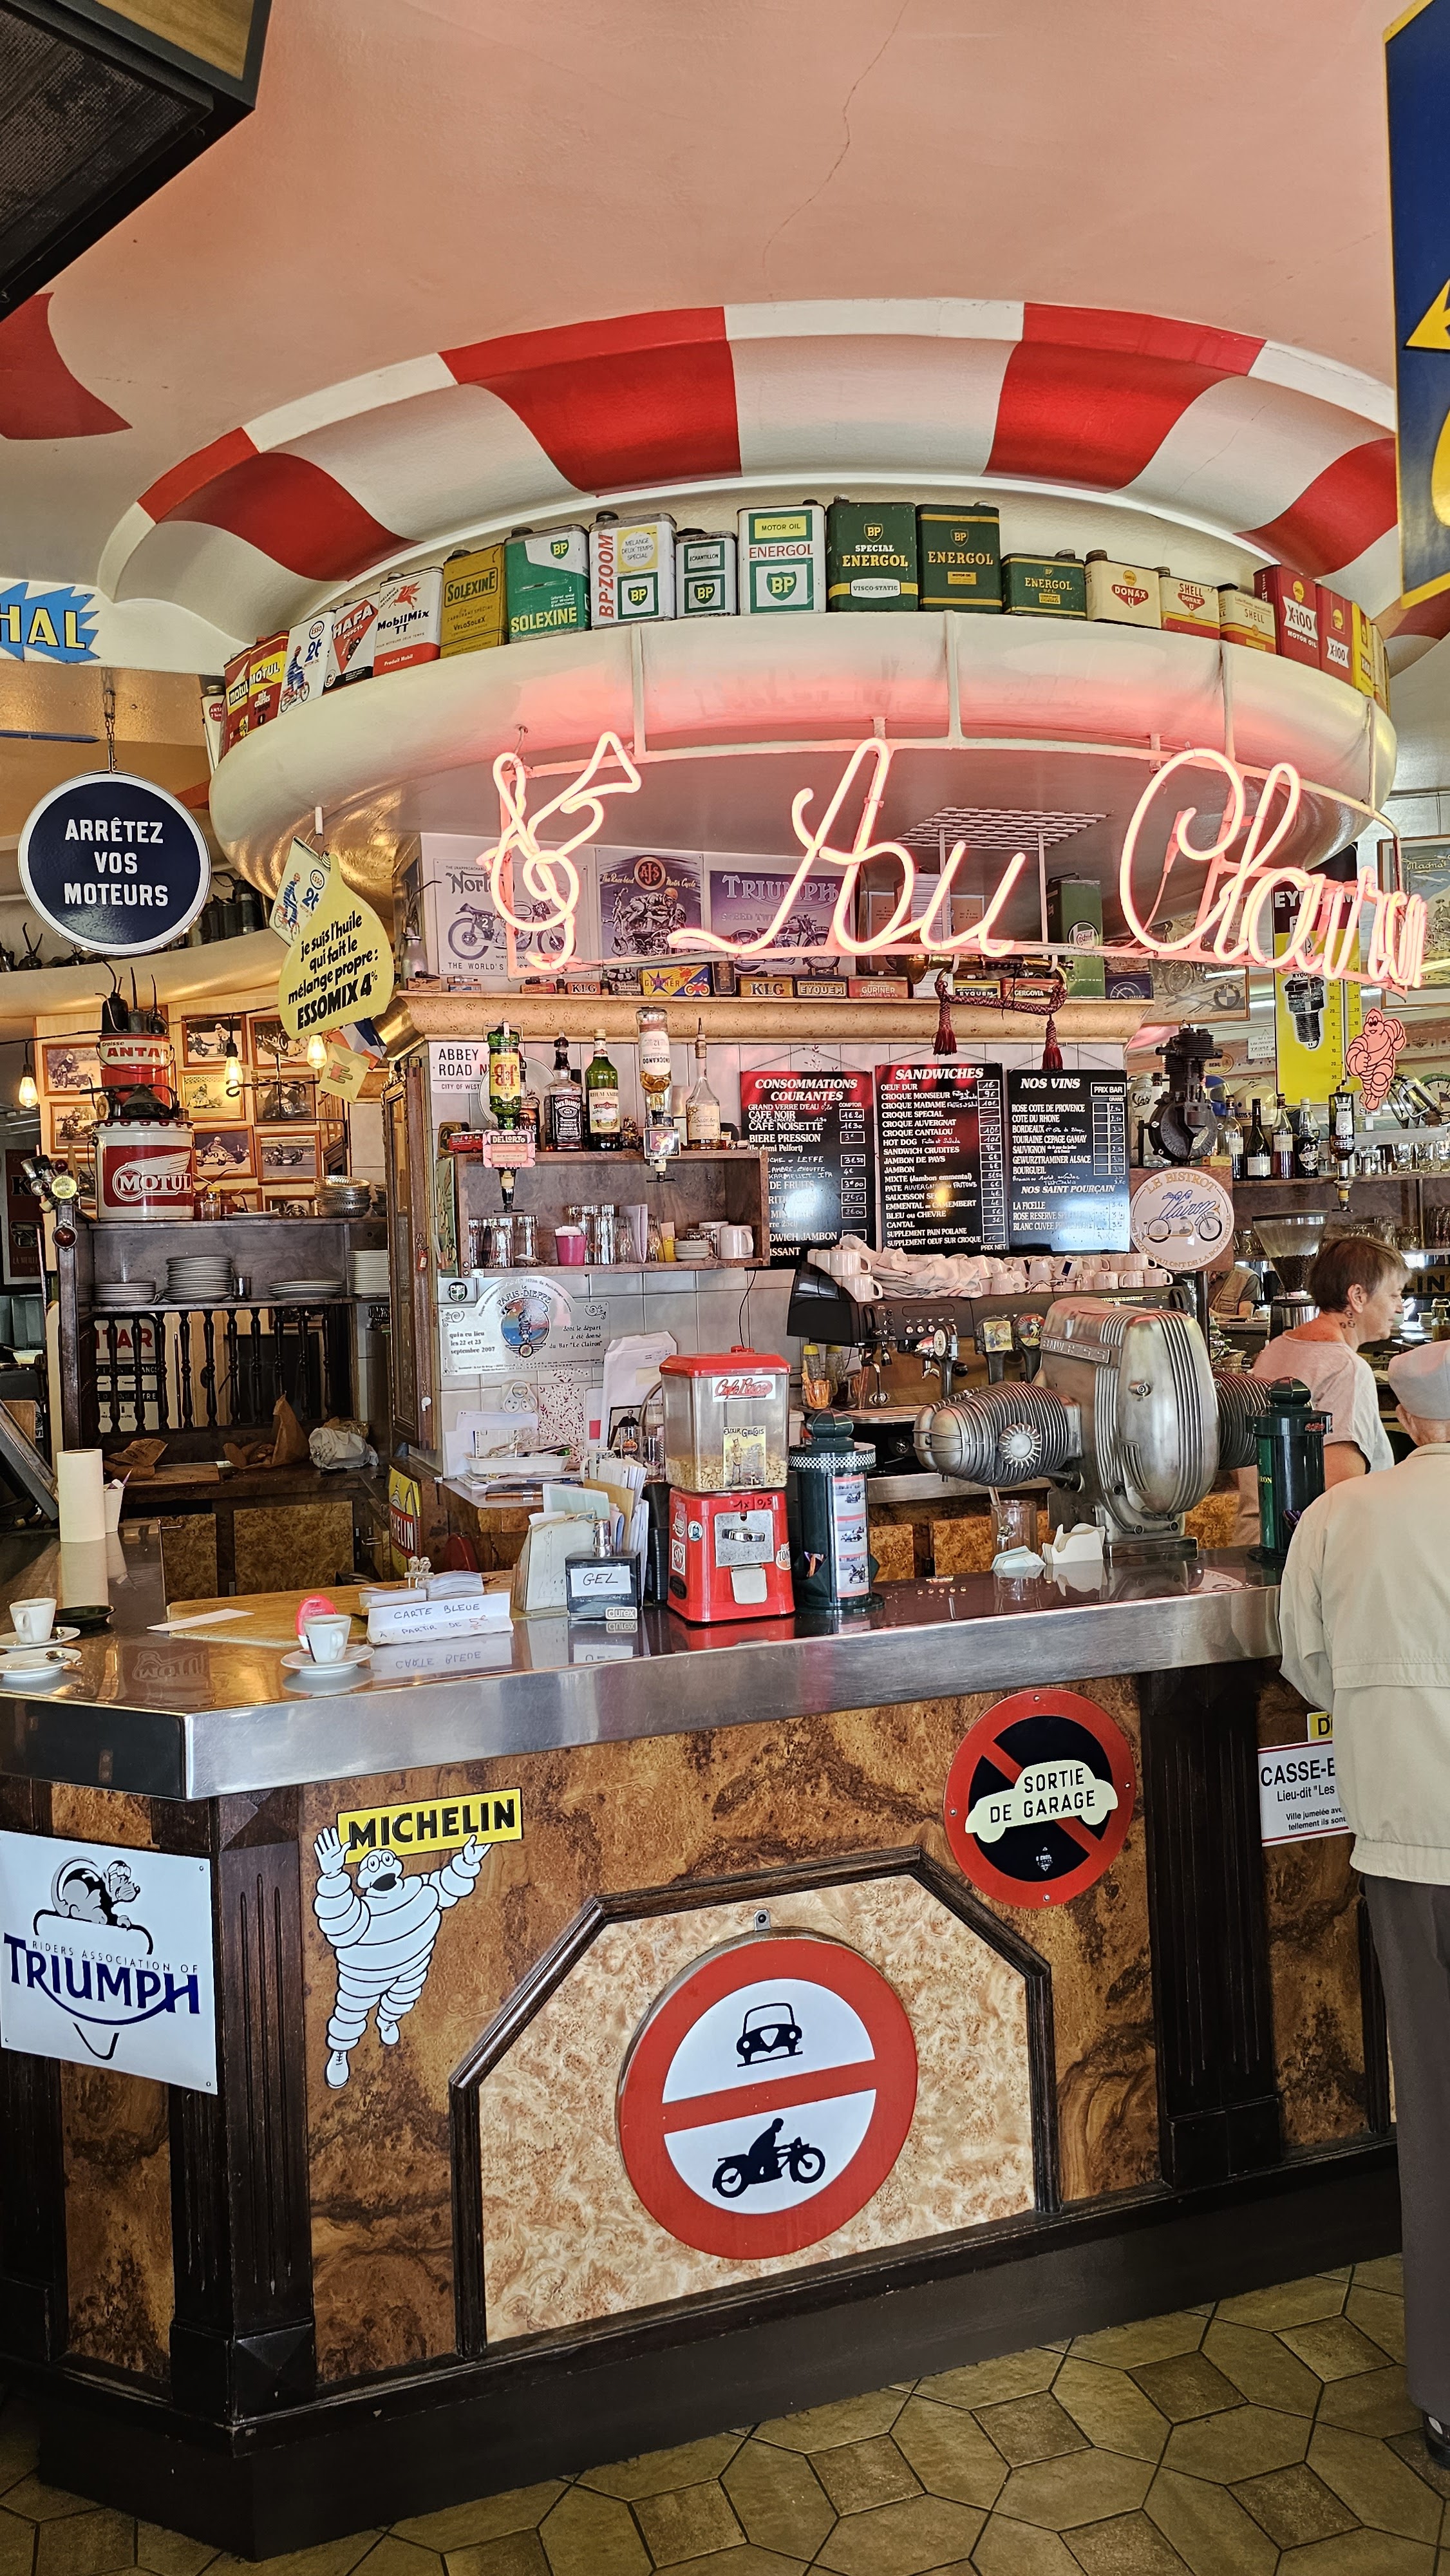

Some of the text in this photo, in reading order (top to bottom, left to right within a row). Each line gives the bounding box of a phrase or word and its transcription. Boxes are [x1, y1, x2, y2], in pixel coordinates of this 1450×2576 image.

[867, 527, 881, 536] BP
[954, 532, 966, 542] BP
[553, 543, 568, 555] BP
[749, 544, 813, 558] ENERGOL
[842, 555, 909, 567] ENERGOL
[928, 551, 993, 565] ENERGOL
[447, 571, 495, 602] SOLEXINE
[771, 576, 795, 593] BP
[1025, 577, 1073, 591] ENERGOL
[1179, 583, 1203, 598] SHELL
[630, 589, 646, 601] BP
[697, 587, 713, 600] BP
[1115, 585, 1146, 600] DONAX
[1127, 597, 1134, 607] U
[1182, 595, 1201, 605] DONAX
[332, 605, 375, 639] HAFA
[377, 611, 429, 631] MobilMix
[511, 607, 576, 633] SOLEXINE
[1245, 609, 1265, 623] SHELL
[394, 623, 408, 634] TT
[1288, 630, 1317, 648] MOTOR OIL
[1330, 643, 1345, 661] X-100
[384, 654, 413, 666] Produit Mobil
[249, 661, 280, 686] MOTUL
[229, 679, 249, 703] motul
[65, 817, 163, 845] ARRÊTEZ
[668, 737, 1027, 957] Au
[94, 852, 138, 874] VOS
[639, 862, 660, 884] AJS
[64, 883, 169, 907] MOTEURS
[482, 918, 489, 928] 2
[301, 940, 310, 963] je
[311, 929, 330, 951] suis
[310, 935, 358, 974] qui fait le
[288, 971, 334, 1005] mélange
[572, 984, 596, 994] KLG
[751, 983, 784, 996] KLG
[800, 985, 844, 996] EYQUEM
[297, 978, 359, 1031] ESSOMIX
[107, 1047, 169, 1059] ANTAR
[438, 1048, 479, 1061] ABBEY
[439, 1065, 472, 1076] ROAD
[896, 1068, 984, 1080] SANDWICHES
[755, 1079, 858, 1089] CONSOMMATIONS
[1020, 1078, 1080, 1088] NOS VINS
[771, 1092, 843, 1101] COURANTES
[1055, 1104, 1085, 1112] PROVENCE
[749, 1133, 821, 1143] BIERE PRESSION
[1012, 1135, 1087, 1144] TOURAINE CEPAGE GAMAY
[1012, 1145, 1046, 1153] SAUVIGNON
[1012, 1155, 1091, 1164] GEWURZTRAMINER ALSACE
[1013, 1166, 1046, 1175] BOURGUEIL
[119, 1175, 191, 1191] MOTUL
[1145, 1171, 1217, 1194] LE BISTROT
[1021, 1186, 1040, 1194] NOS
[1070, 1185, 1115, 1195] POURÇAIN
[1030, 1211, 1057, 1220] RESERVE
[801, 1232, 837, 1241] JAMBON
[497, 1290, 552, 1307] PARIS-DIEPPE
[583, 1573, 618, 1586] GEL
[394, 1604, 480, 1619] CARTE BLEUE
[608, 1609, 634, 1617] durex
[402, 1624, 437, 1634] PARTIR
[1024, 1768, 1084, 1794] SORTIE
[1277, 1788, 1312, 1802] Lieu-dit
[990, 1790, 1096, 1824] DE GARAGE
[1303, 1808, 1330, 1820] jumelée
[347, 1798, 516, 1852] MICHELIN
[1288, 1819, 1319, 1831] tellement
[33, 1940, 198, 1973] RIDERS ASSOCIATION OF
[3, 1933, 200, 2025] TRIUMPH
